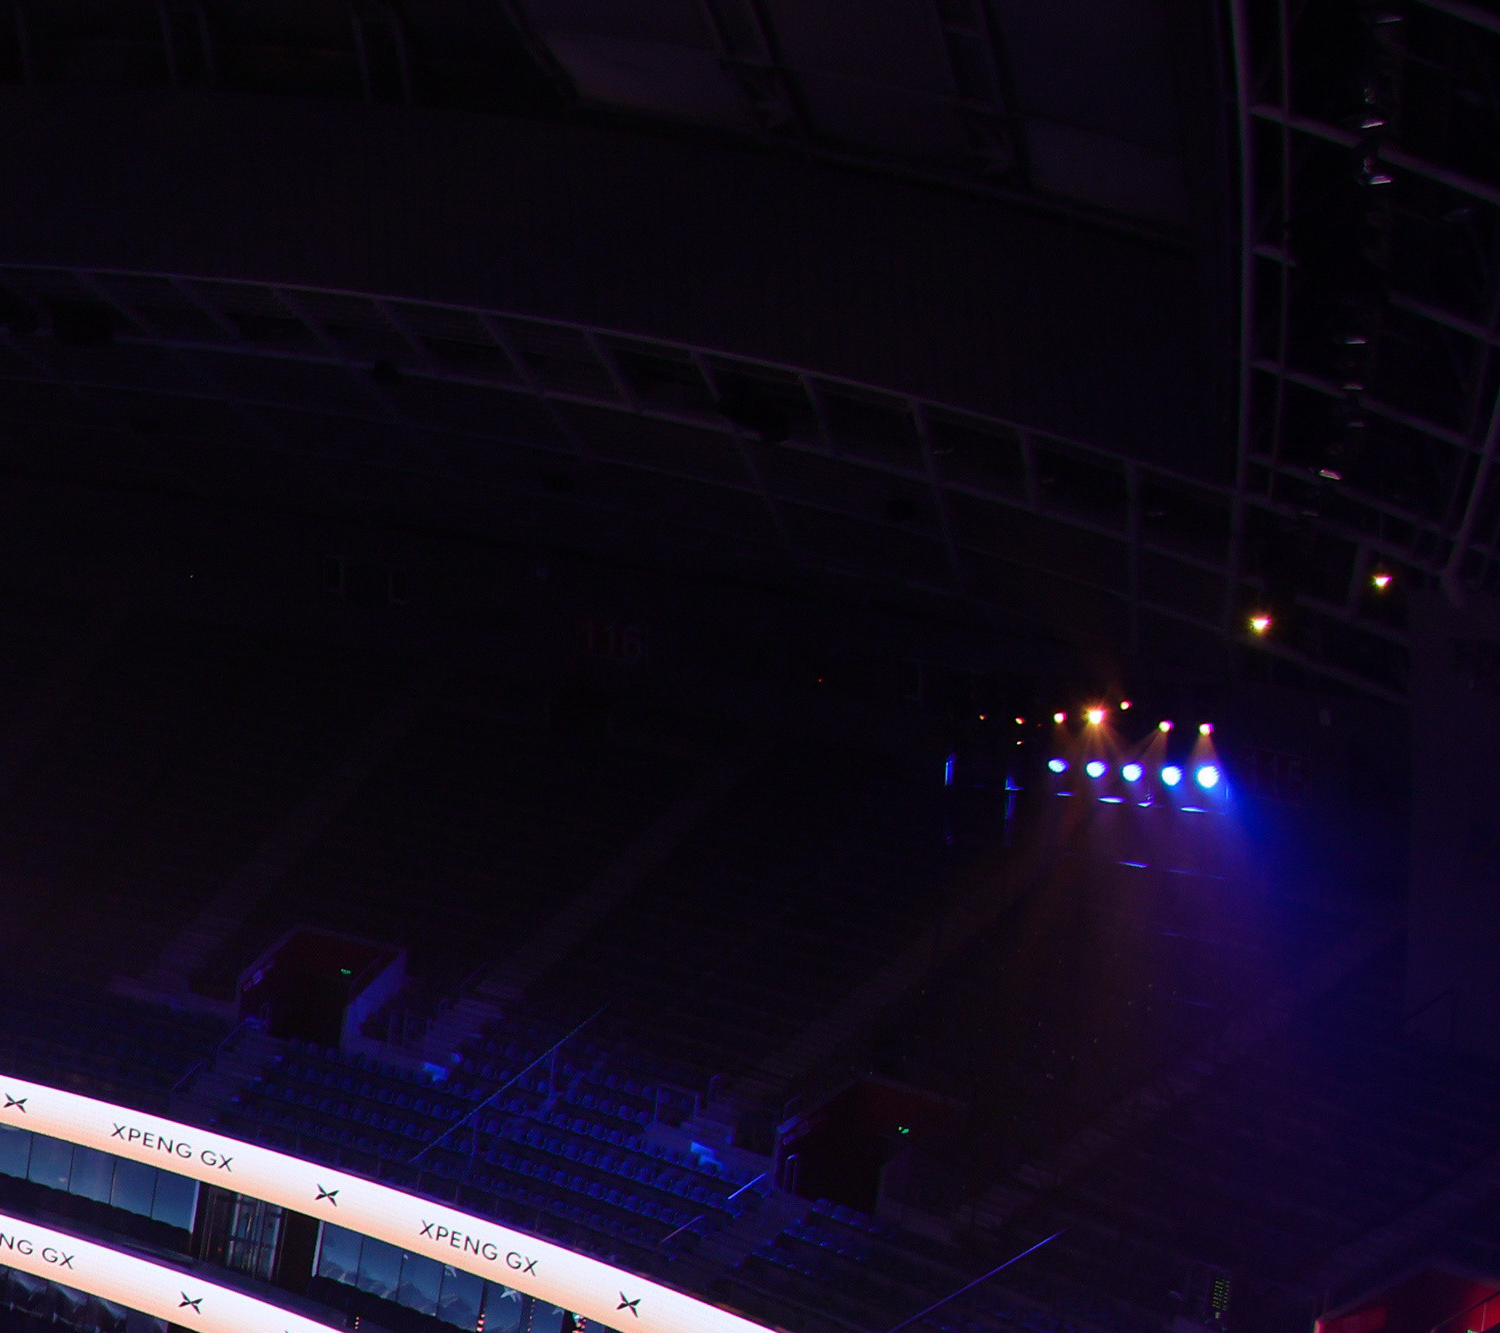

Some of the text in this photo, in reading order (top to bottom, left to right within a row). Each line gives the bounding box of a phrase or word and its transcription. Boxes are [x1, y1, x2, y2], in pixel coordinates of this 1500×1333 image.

[110, 1122, 233, 1173] XPENG GX
[41, 1247, 75, 1270] GX
[419, 1219, 538, 1277] XPENG GX
